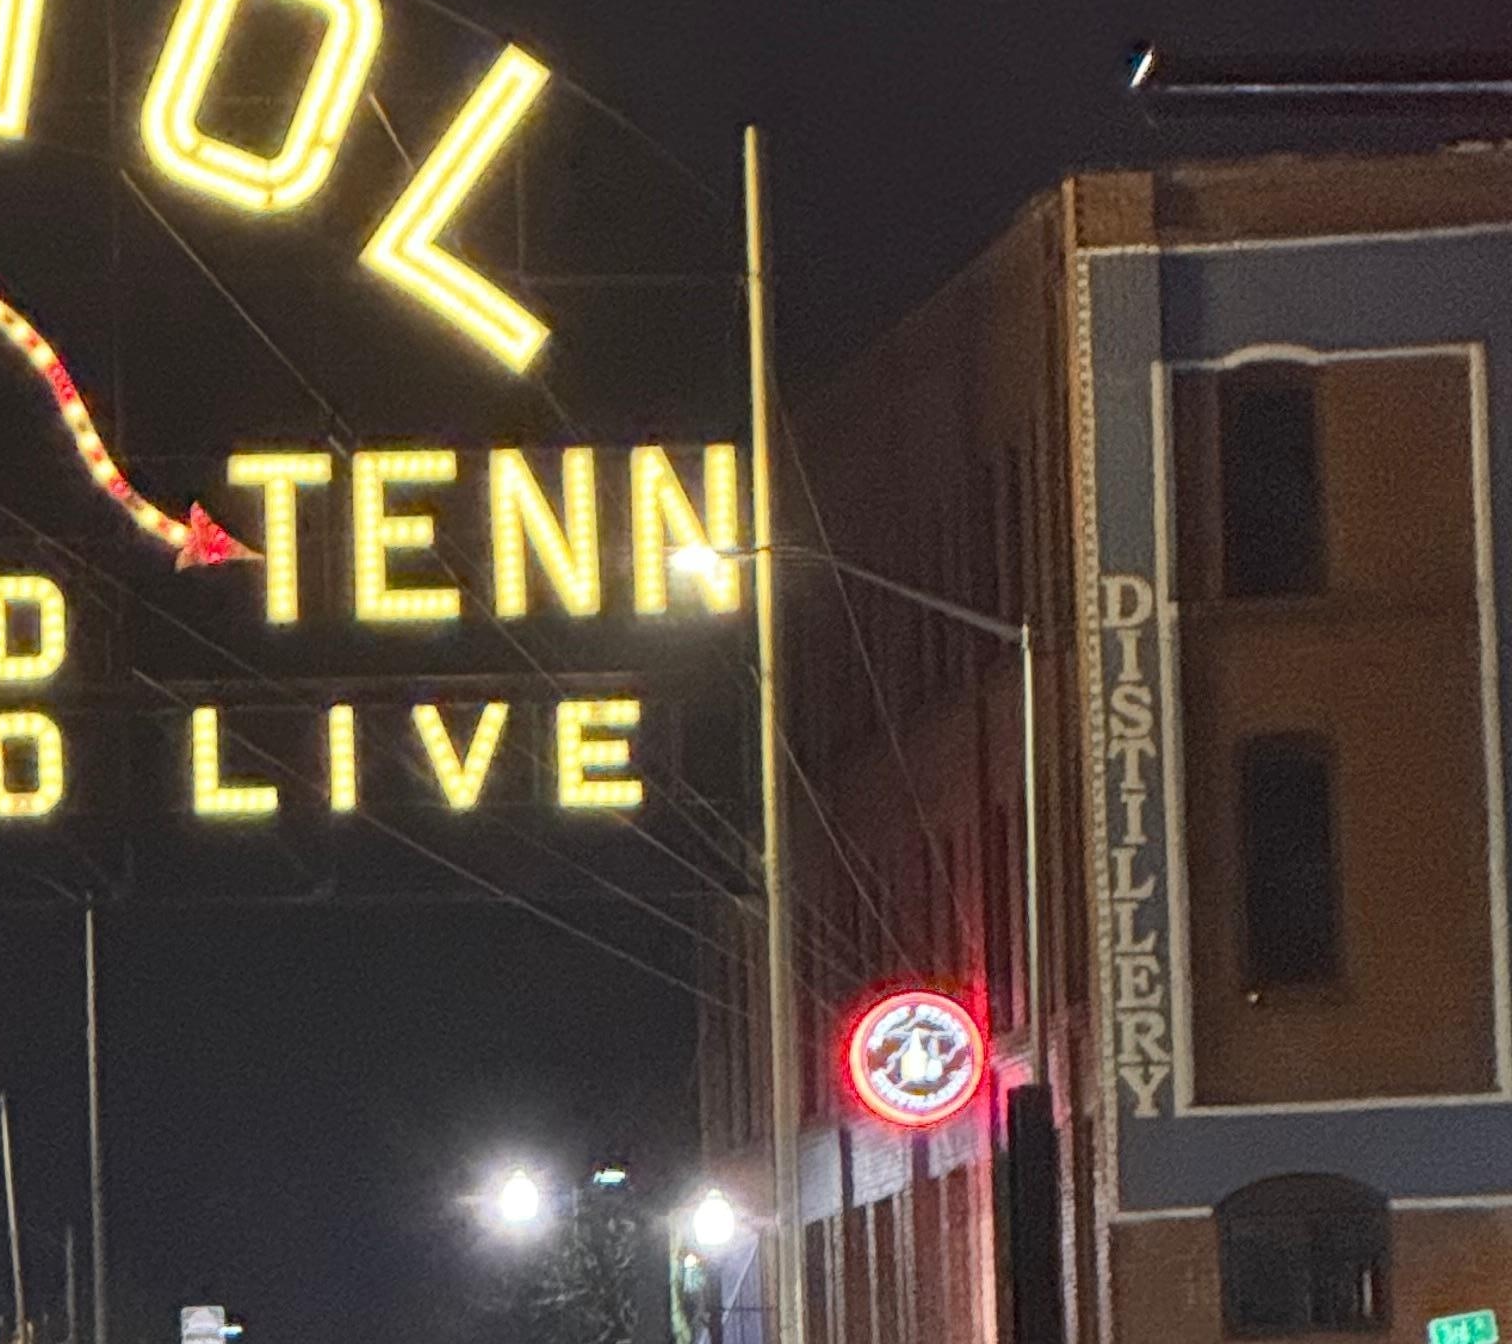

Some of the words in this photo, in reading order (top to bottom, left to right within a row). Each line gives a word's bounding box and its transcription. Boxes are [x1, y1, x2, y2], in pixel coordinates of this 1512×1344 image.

[227, 443, 742, 624] TENN
[192, 699, 644, 817] LIVE
[1101, 575, 1172, 1119] DISTILLERY
